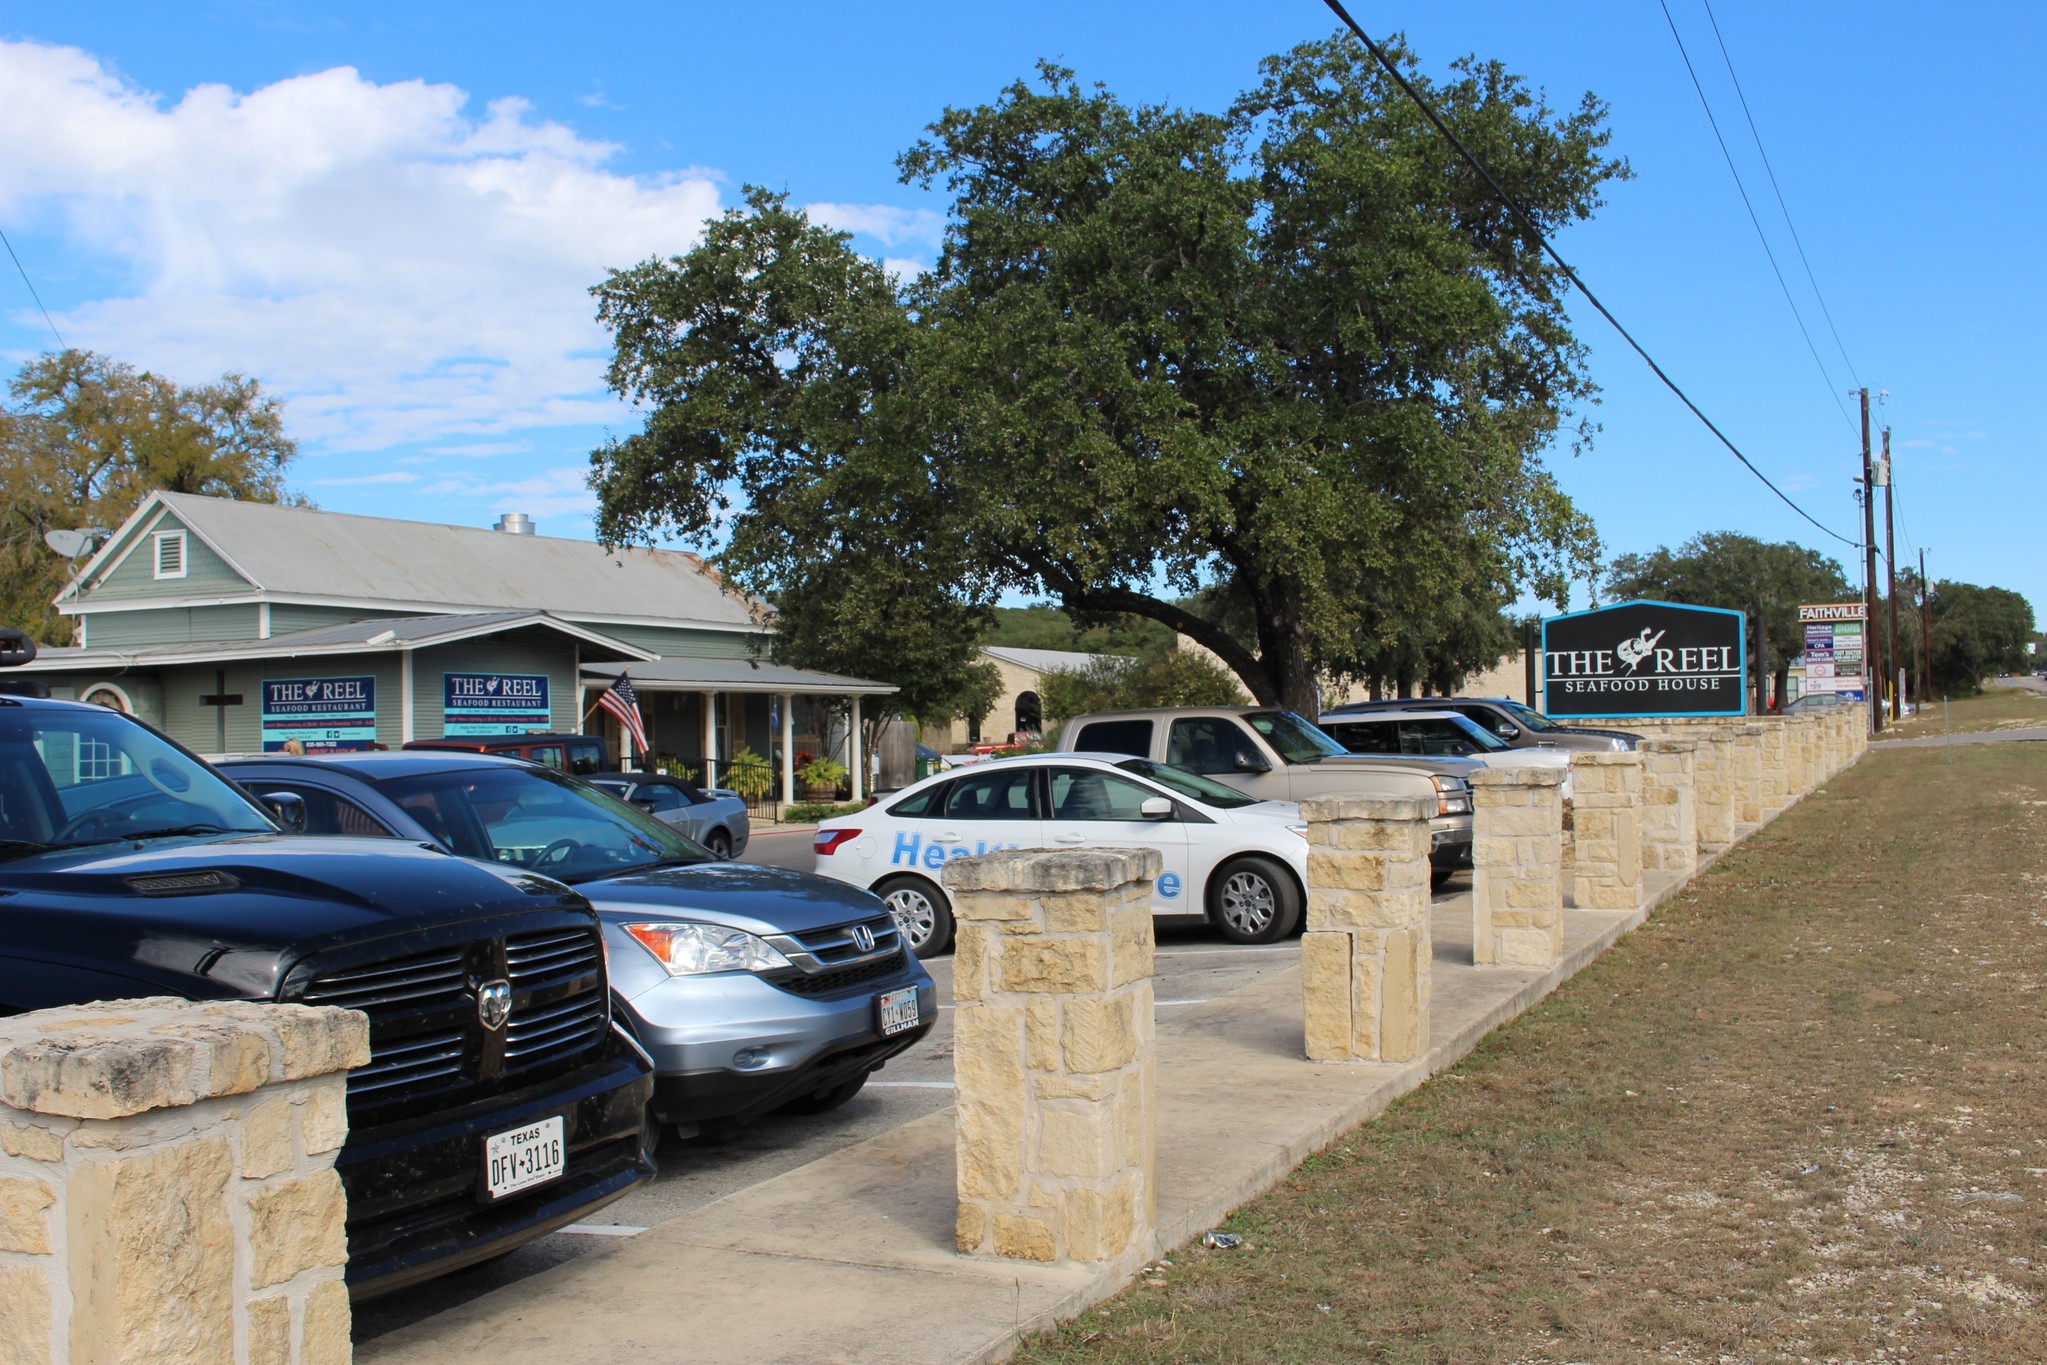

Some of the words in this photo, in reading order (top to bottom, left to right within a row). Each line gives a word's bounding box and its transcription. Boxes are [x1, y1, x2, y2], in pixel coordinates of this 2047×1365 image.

[1800, 606, 1864, 619] FAITHVILLE
[1546, 650, 1614, 676] THE
[1655, 646, 1740, 673] REEL
[270, 684, 304, 701] THE
[323, 682, 366, 699] REEL
[452, 678, 484, 695] THE
[502, 679, 541, 696] REEL
[1566, 679, 1649, 692] SEAFOOD
[1658, 678, 1720, 690] HOUSE
[271, 704, 308, 713] SEAFOOD
[312, 703, 366, 712] RESTAURANT
[886, 1019, 919, 1035] GILLMAN
[511, 1128, 540, 1146] TEXAS
